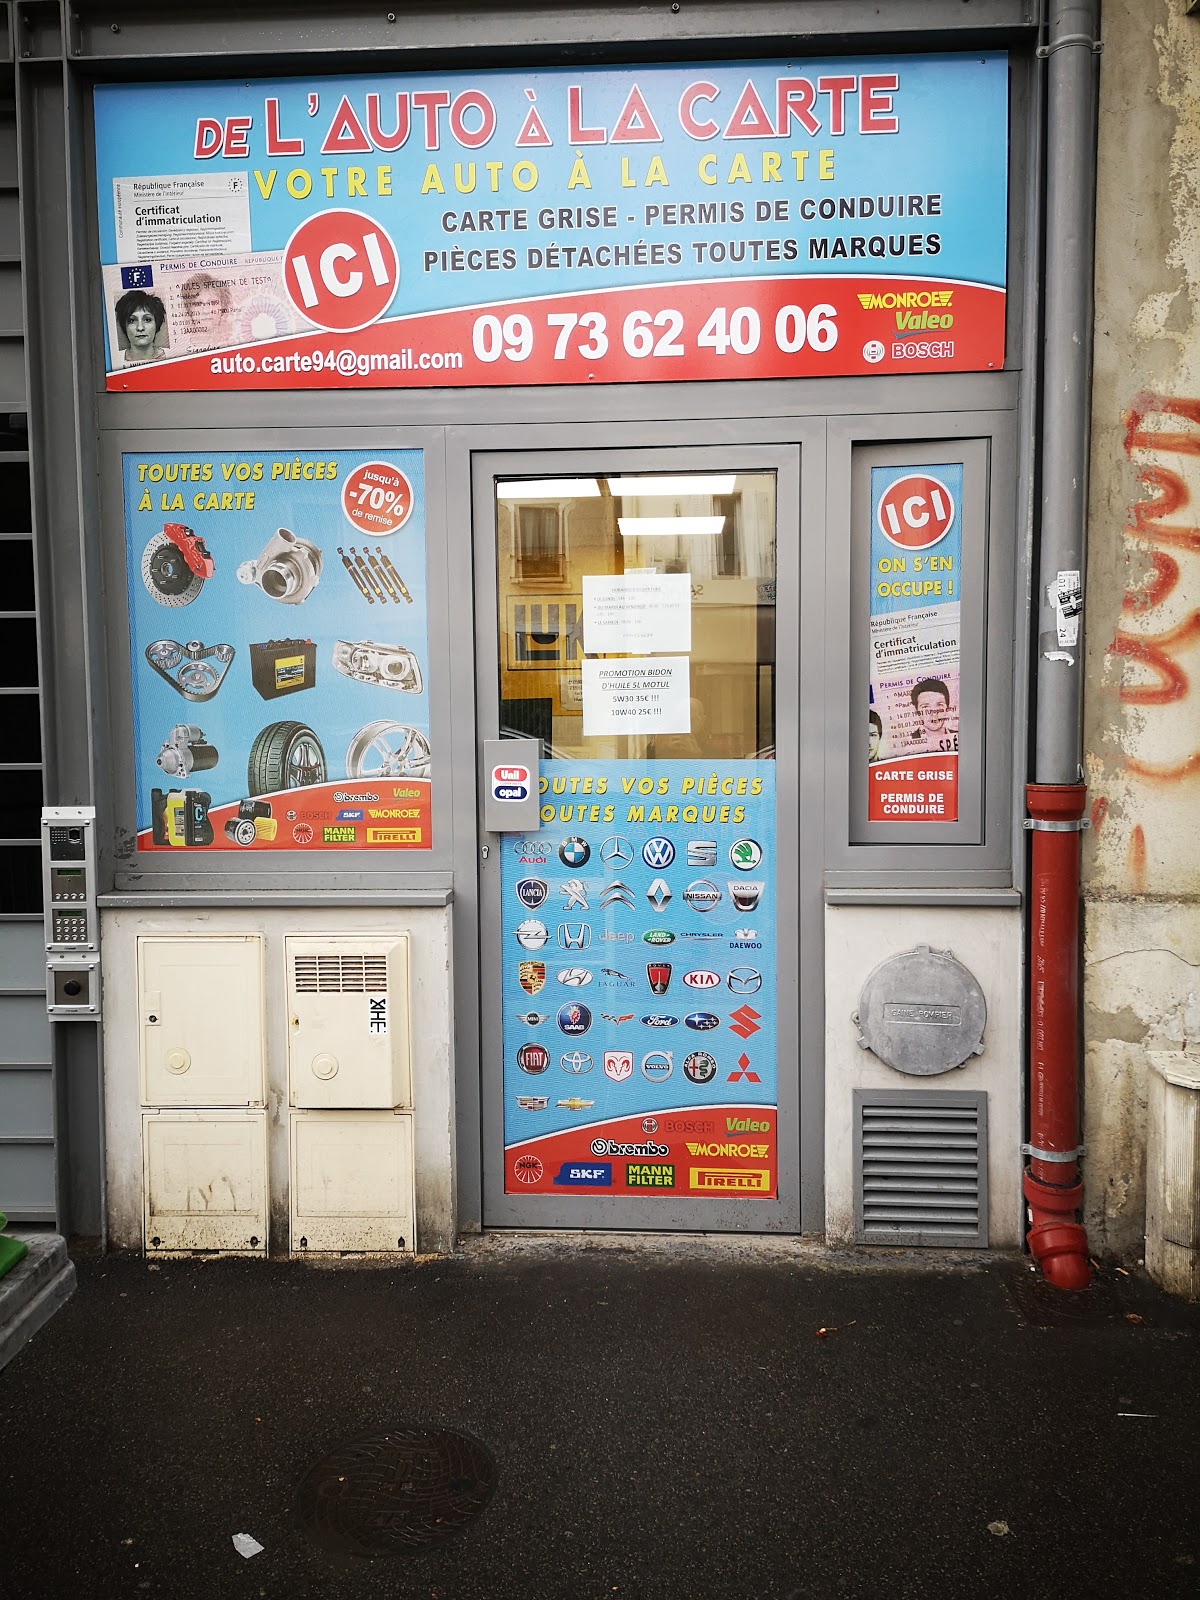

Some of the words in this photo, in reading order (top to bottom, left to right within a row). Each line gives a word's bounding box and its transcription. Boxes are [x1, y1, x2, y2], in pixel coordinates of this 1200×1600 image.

[194, 116, 253, 160] DE
[264, 89, 496, 156] L'AUTO
[514, 89, 552, 148] À
[568, 83, 663, 144] LA
[679, 73, 899, 141] CARTE
[253, 164, 392, 200] VOTRE
[420, 160, 539, 195] AUTO
[567, 149, 592, 190] À
[621, 155, 669, 187] LA
[698, 148, 835, 184] CARTE
[133, 182, 172, 191] République
[174, 180, 204, 190] Française
[135, 205, 180, 216] Certificat
[441, 208, 528, 233] CARTE
[538, 206, 618, 230] GRISE
[644, 200, 745, 226] PERMIS
[756, 198, 790, 223] DE
[800, 194, 942, 220] CONDUIRE
[136, 214, 222, 226] d'immatriculation
[423, 246, 517, 273] PIÈCES
[527, 238, 682, 270] DÉTACHÉES
[692, 238, 798, 264] TOUTES
[808, 233, 942, 260] MARQUES
[160, 263, 186, 271] PERMIS
[291, 232, 389, 309] ICI
[133, 272, 140, 282] F
[867, 291, 945, 310] MONROE
[896, 312, 954, 330] Valeo
[472, 313, 534, 362] 09
[548, 311, 608, 360] 73
[622, 309, 684, 358] 62
[698, 306, 760, 355] 40
[775, 304, 838, 352] 06
[891, 342, 954, 358] BOSCH
[210, 348, 464, 375] auto.carte94@gmail.com
[138, 462, 214, 482] TOUTES
[221, 462, 264, 481] VOS
[272, 457, 338, 481] PIÈCES
[363, 469, 400, 488] jusqu'à
[138, 489, 152, 512] À
[160, 492, 185, 511] LA
[193, 492, 256, 510] CARTE
[349, 483, 404, 518] -70%
[352, 508, 364, 518] de
[364, 512, 393, 527] remise
[885, 489, 946, 534] ICI
[878, 556, 906, 574] ON
[913, 556, 953, 572] S'EN
[877, 580, 942, 598] OCCUPE
[908, 610, 938, 621] Française
[874, 636, 916, 650] Certificat
[876, 639, 957, 658] d'immatriculation
[598, 668, 646, 678] PROMOTION
[648, 668, 673, 676] BIDON
[602, 682, 631, 690] D'HUILE
[642, 681, 670, 689] MOTUL
[880, 680, 904, 689] PERMIS
[906, 678, 914, 686] DE
[636, 694, 650, 702] 35€
[651, 694, 660, 702] !!!
[611, 708, 636, 716] 10W40
[638, 708, 652, 716] 25€
[500, 770, 520, 780] Unil
[875, 771, 914, 780] CARTE
[918, 771, 954, 780] GRISE
[539, 776, 609, 795] OUTES
[621, 776, 670, 795] VOS
[681, 772, 763, 795] PIÈCES
[344, 793, 378, 802] brembo
[393, 788, 420, 798] Valeo
[499, 787, 521, 798] opal
[880, 793, 924, 802] PERMIS
[928, 793, 944, 802] DE
[372, 809, 417, 818] MONROE
[539, 805, 615, 823] OUTES
[627, 805, 746, 824] MARQUES
[883, 804, 944, 814] CONDUIRE
[324, 827, 355, 835] MANN
[373, 830, 417, 841] PIRELLI
[324, 834, 355, 842] FILTER
[518, 856, 546, 864] Audi
[522, 888, 542, 897] LANCIA
[598, 928, 635, 944] Jeep
[690, 974, 714, 985] KIA
[647, 1016, 671, 1026] Ford
[525, 1052, 544, 1066] FIAT
[665, 1120, 714, 1134] BOSCH
[725, 1118, 770, 1133] Valeo
[608, 1140, 669, 1156] brembo
[694, 1142, 762, 1158] MONROE
[519, 1162, 538, 1170] NGK
[628, 1165, 673, 1176] MANN
[570, 1168, 604, 1179] SKF
[697, 1171, 763, 1188] PIRELLI
[628, 1175, 673, 1186] FILTER
